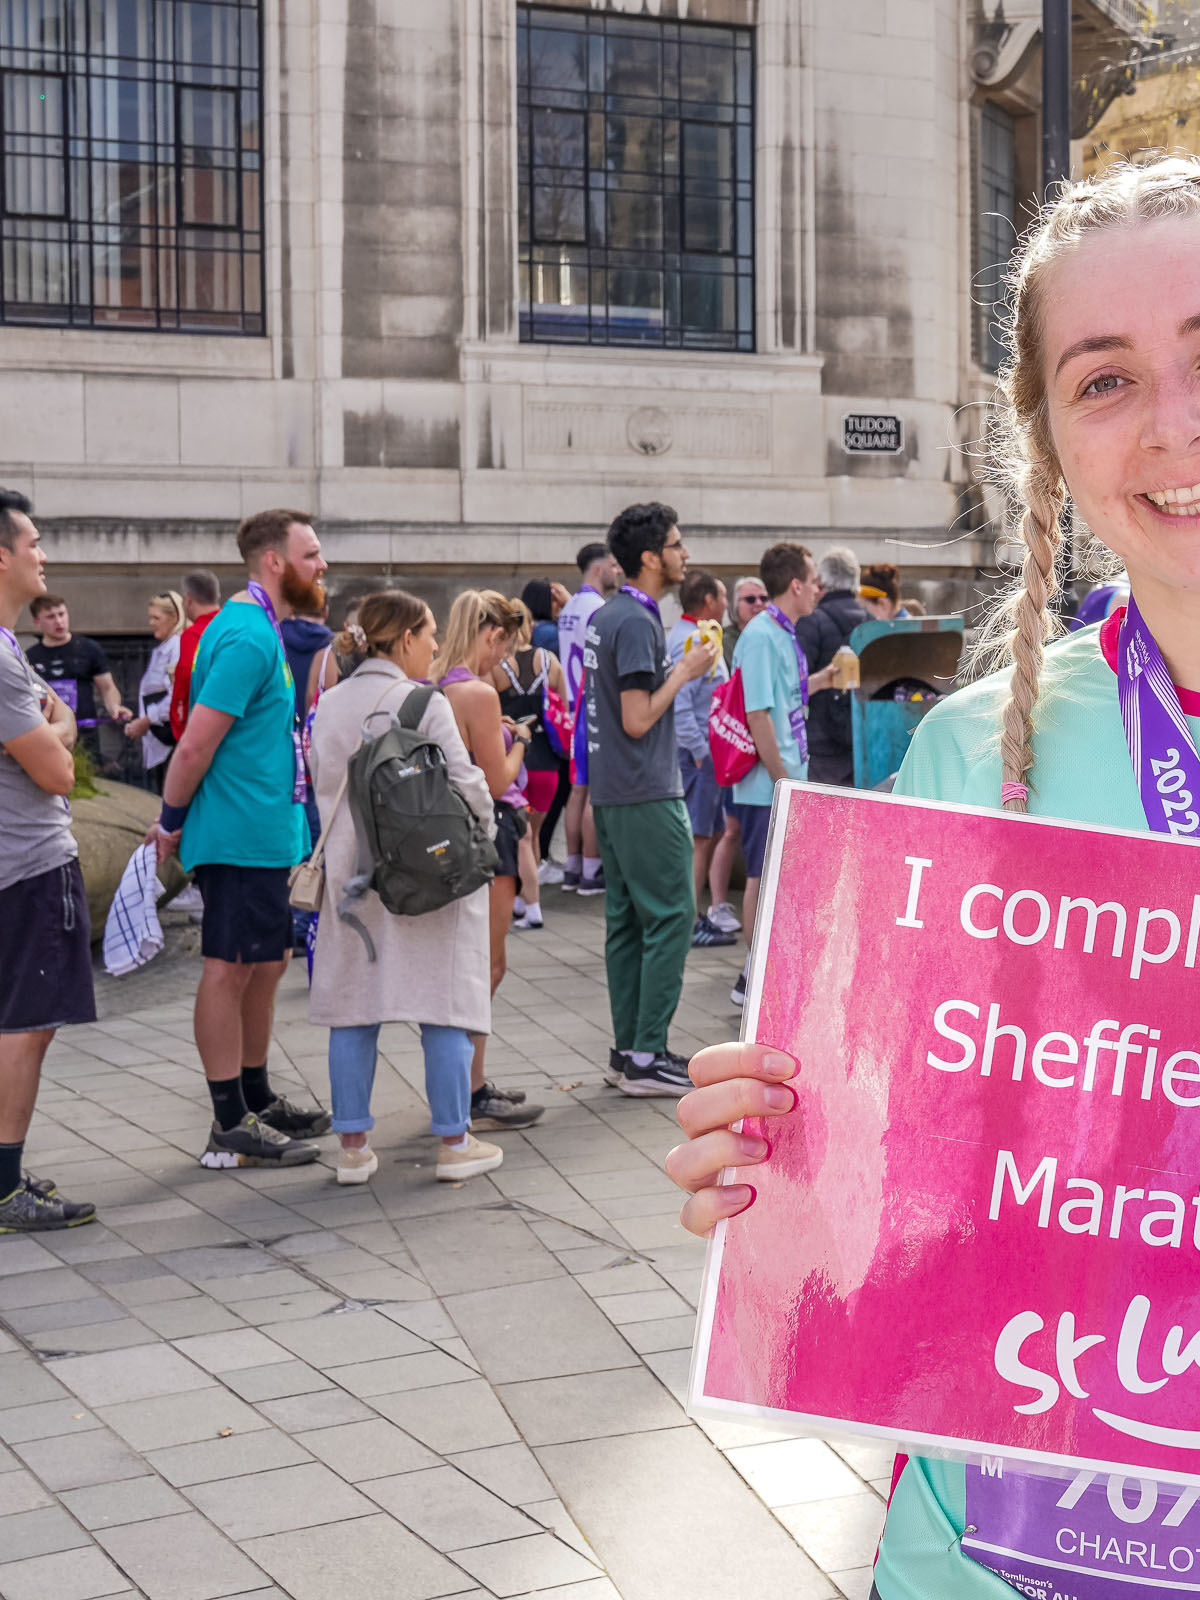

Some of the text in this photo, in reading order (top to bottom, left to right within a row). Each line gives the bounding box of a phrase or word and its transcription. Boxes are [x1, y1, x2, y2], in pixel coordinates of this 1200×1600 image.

[848, 417, 896, 432] TUDOR
[845, 432, 898, 449] SQUARE
[1150, 748, 1200, 837] 2022
[895, 856, 933, 929] I
[994, 1310, 1106, 1415] St
[980, 1455, 1004, 1479] M
[1000, 1569, 1053, 1589] Tomlinson's
